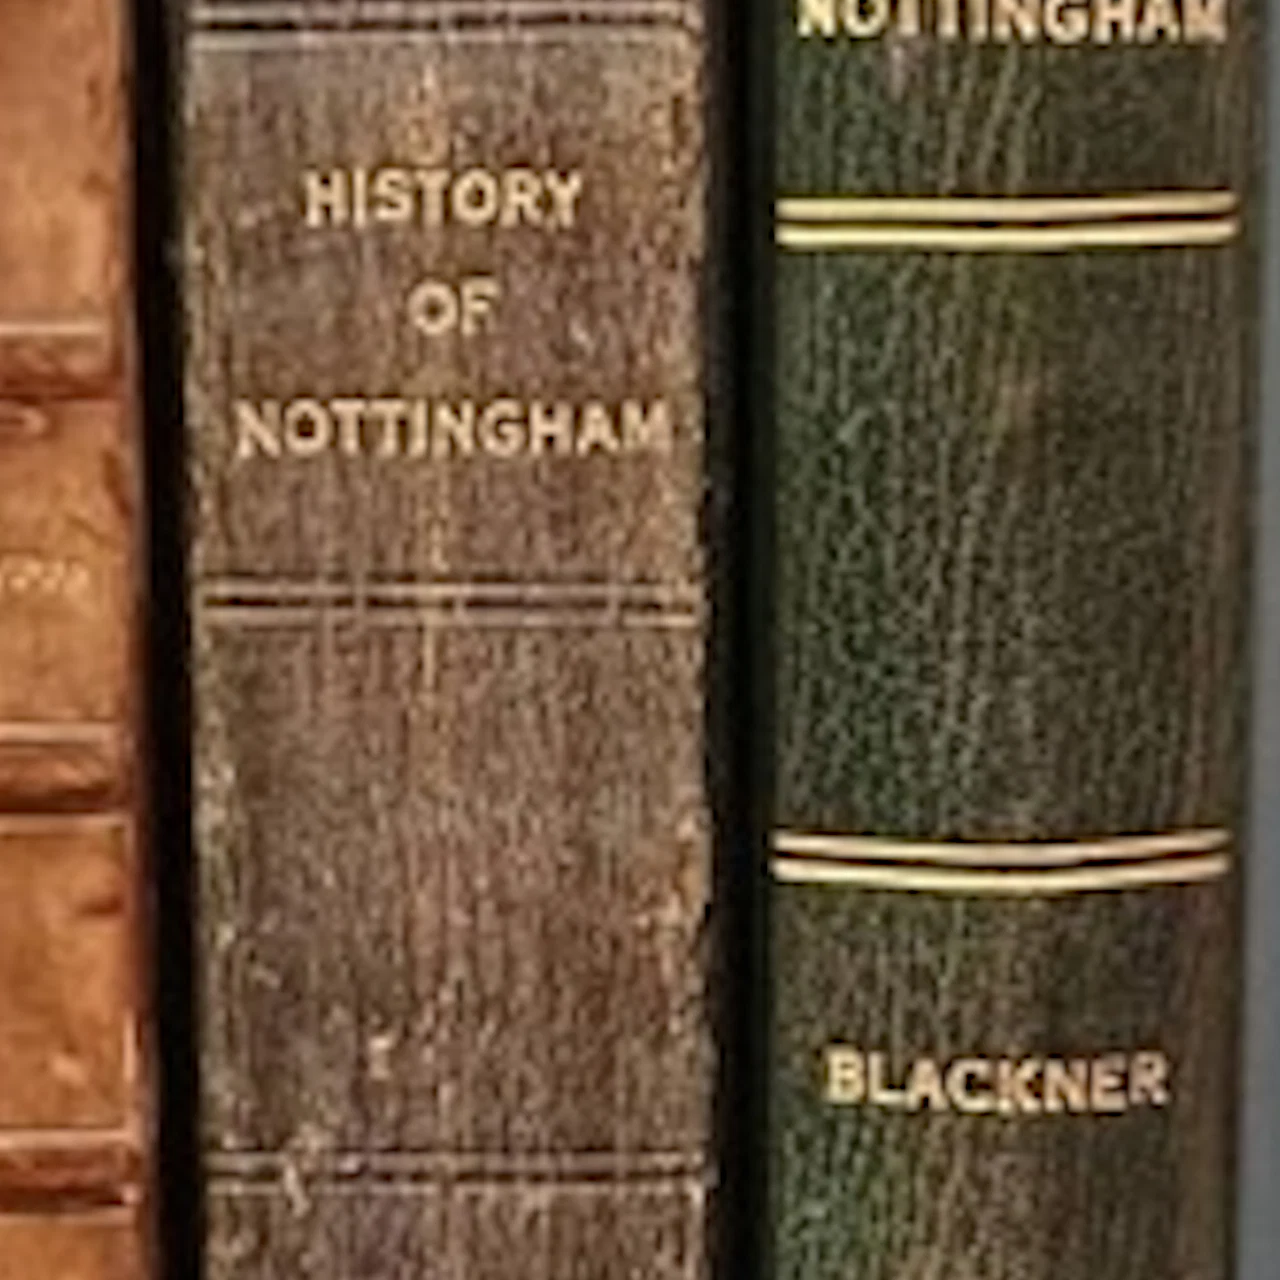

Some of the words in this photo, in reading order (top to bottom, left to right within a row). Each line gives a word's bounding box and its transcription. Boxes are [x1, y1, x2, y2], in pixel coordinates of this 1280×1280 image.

[303, 166, 585, 228] HISTORY
[407, 277, 500, 336] OF
[234, 398, 672, 458] NOTTINGHAM
[825, 1043, 1171, 1115] BLACKNER
